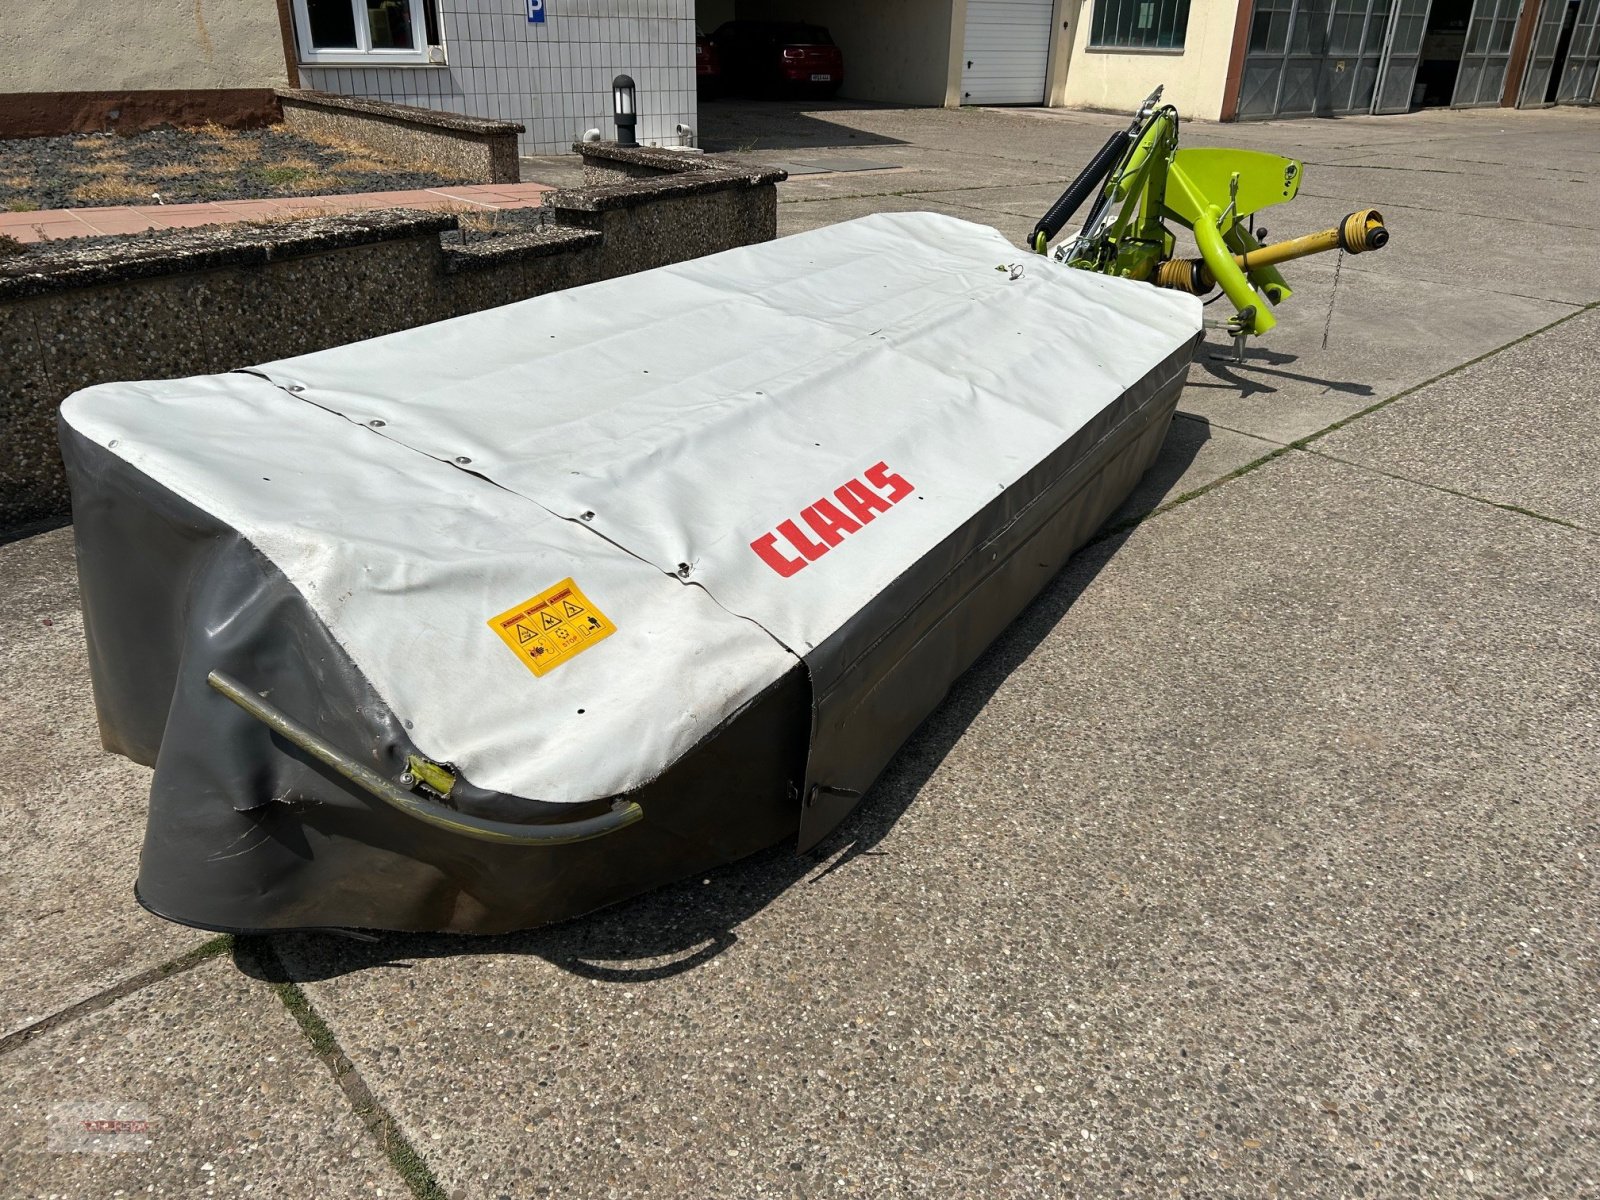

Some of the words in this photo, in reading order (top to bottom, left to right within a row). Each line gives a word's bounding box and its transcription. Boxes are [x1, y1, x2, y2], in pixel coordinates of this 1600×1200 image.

[529, 0, 542, 18] P
[750, 461, 915, 578] CLAAS
[562, 635, 578, 648] STOP
